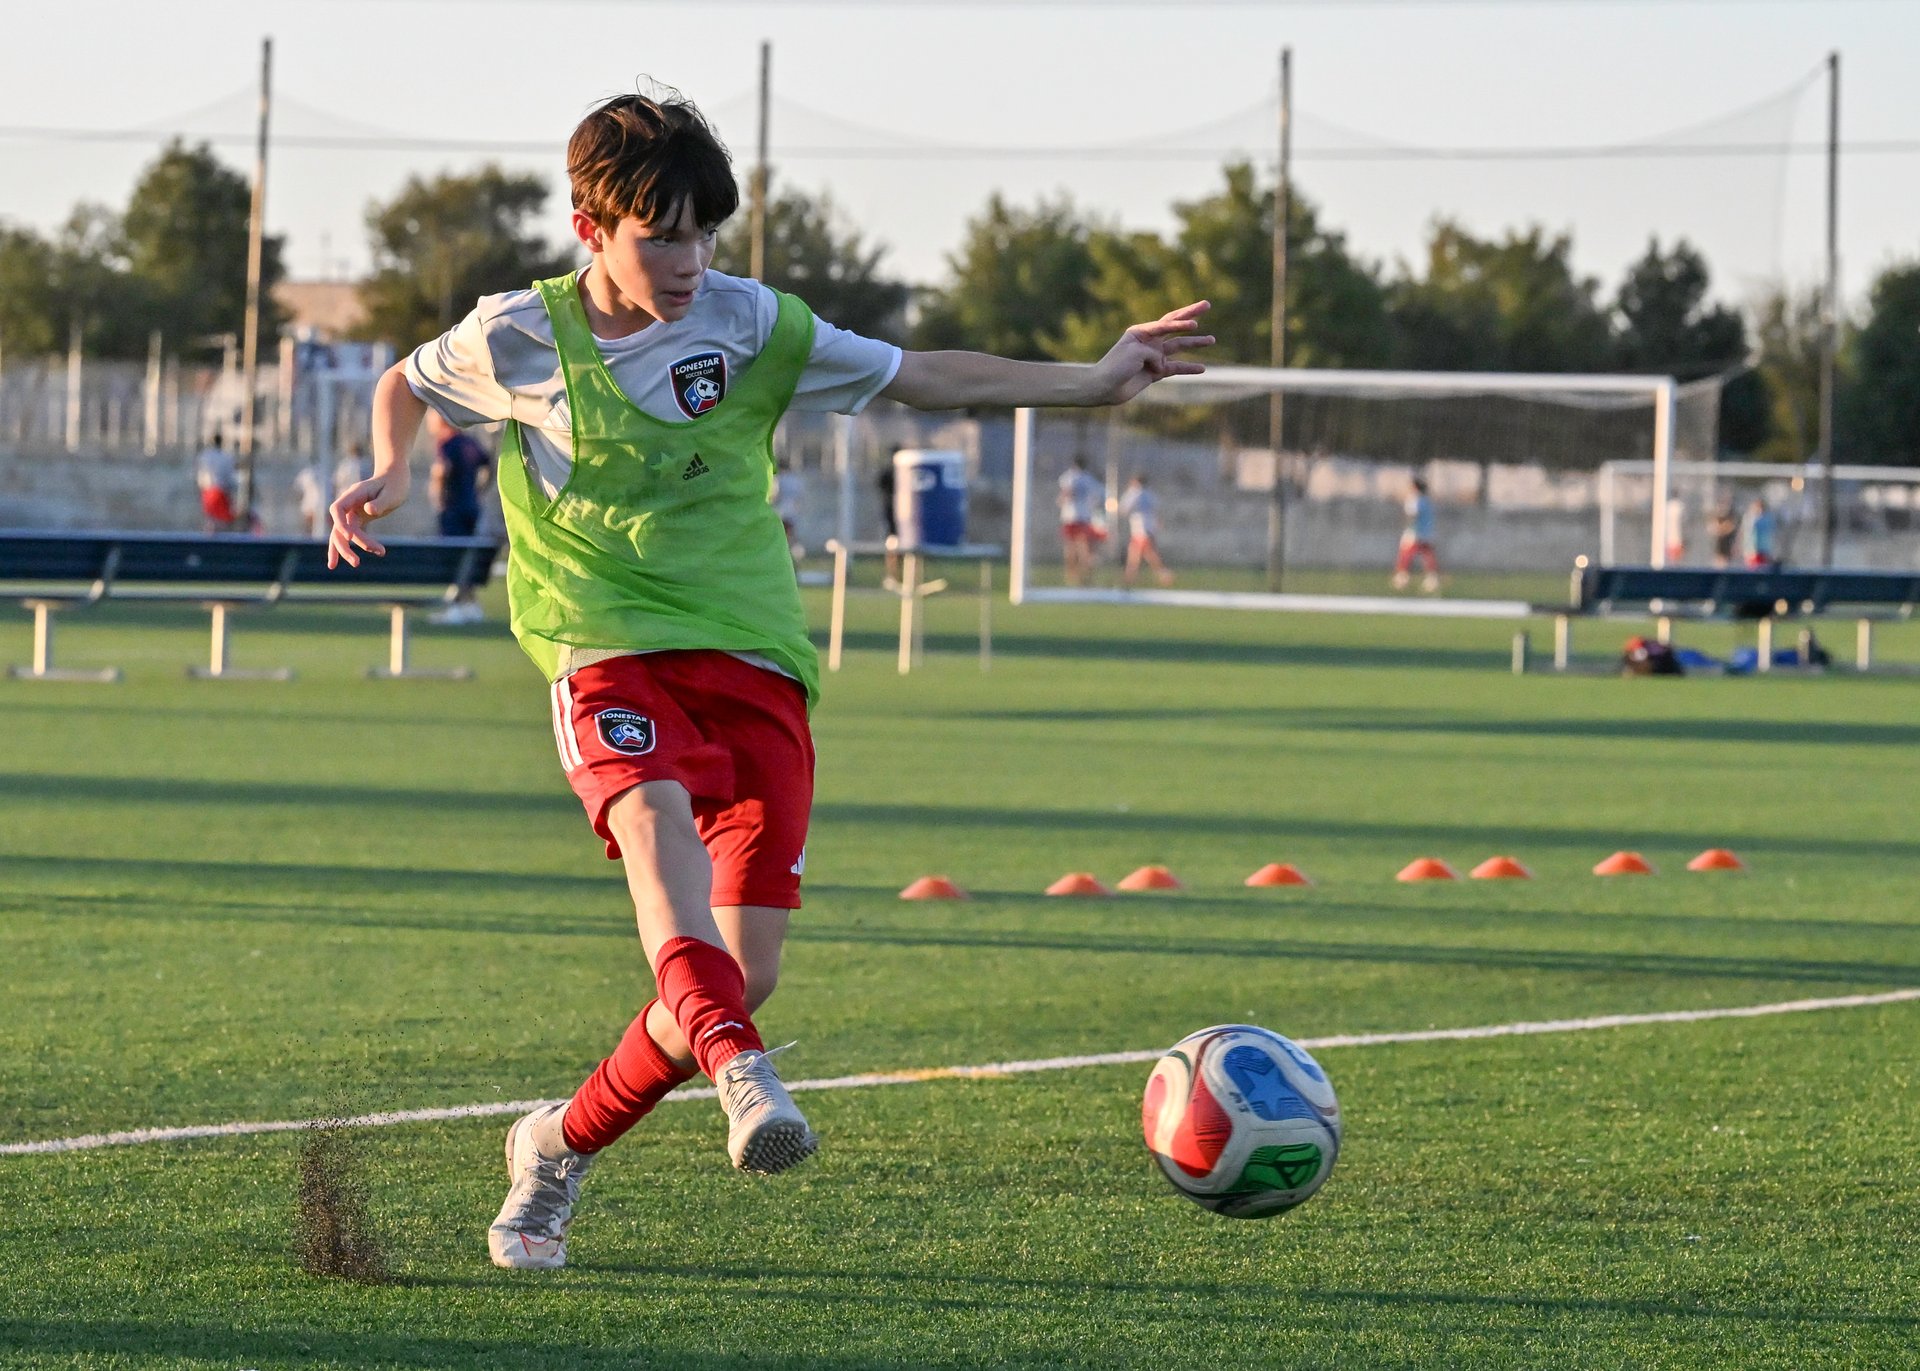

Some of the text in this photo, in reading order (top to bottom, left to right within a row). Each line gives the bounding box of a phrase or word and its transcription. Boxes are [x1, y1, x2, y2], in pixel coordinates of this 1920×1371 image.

[675, 357, 720, 375] LONESTAR
[685, 370, 703, 379] SOCCER
[682, 465, 710, 481] adidas
[602, 713, 647, 722] LONESTAR
